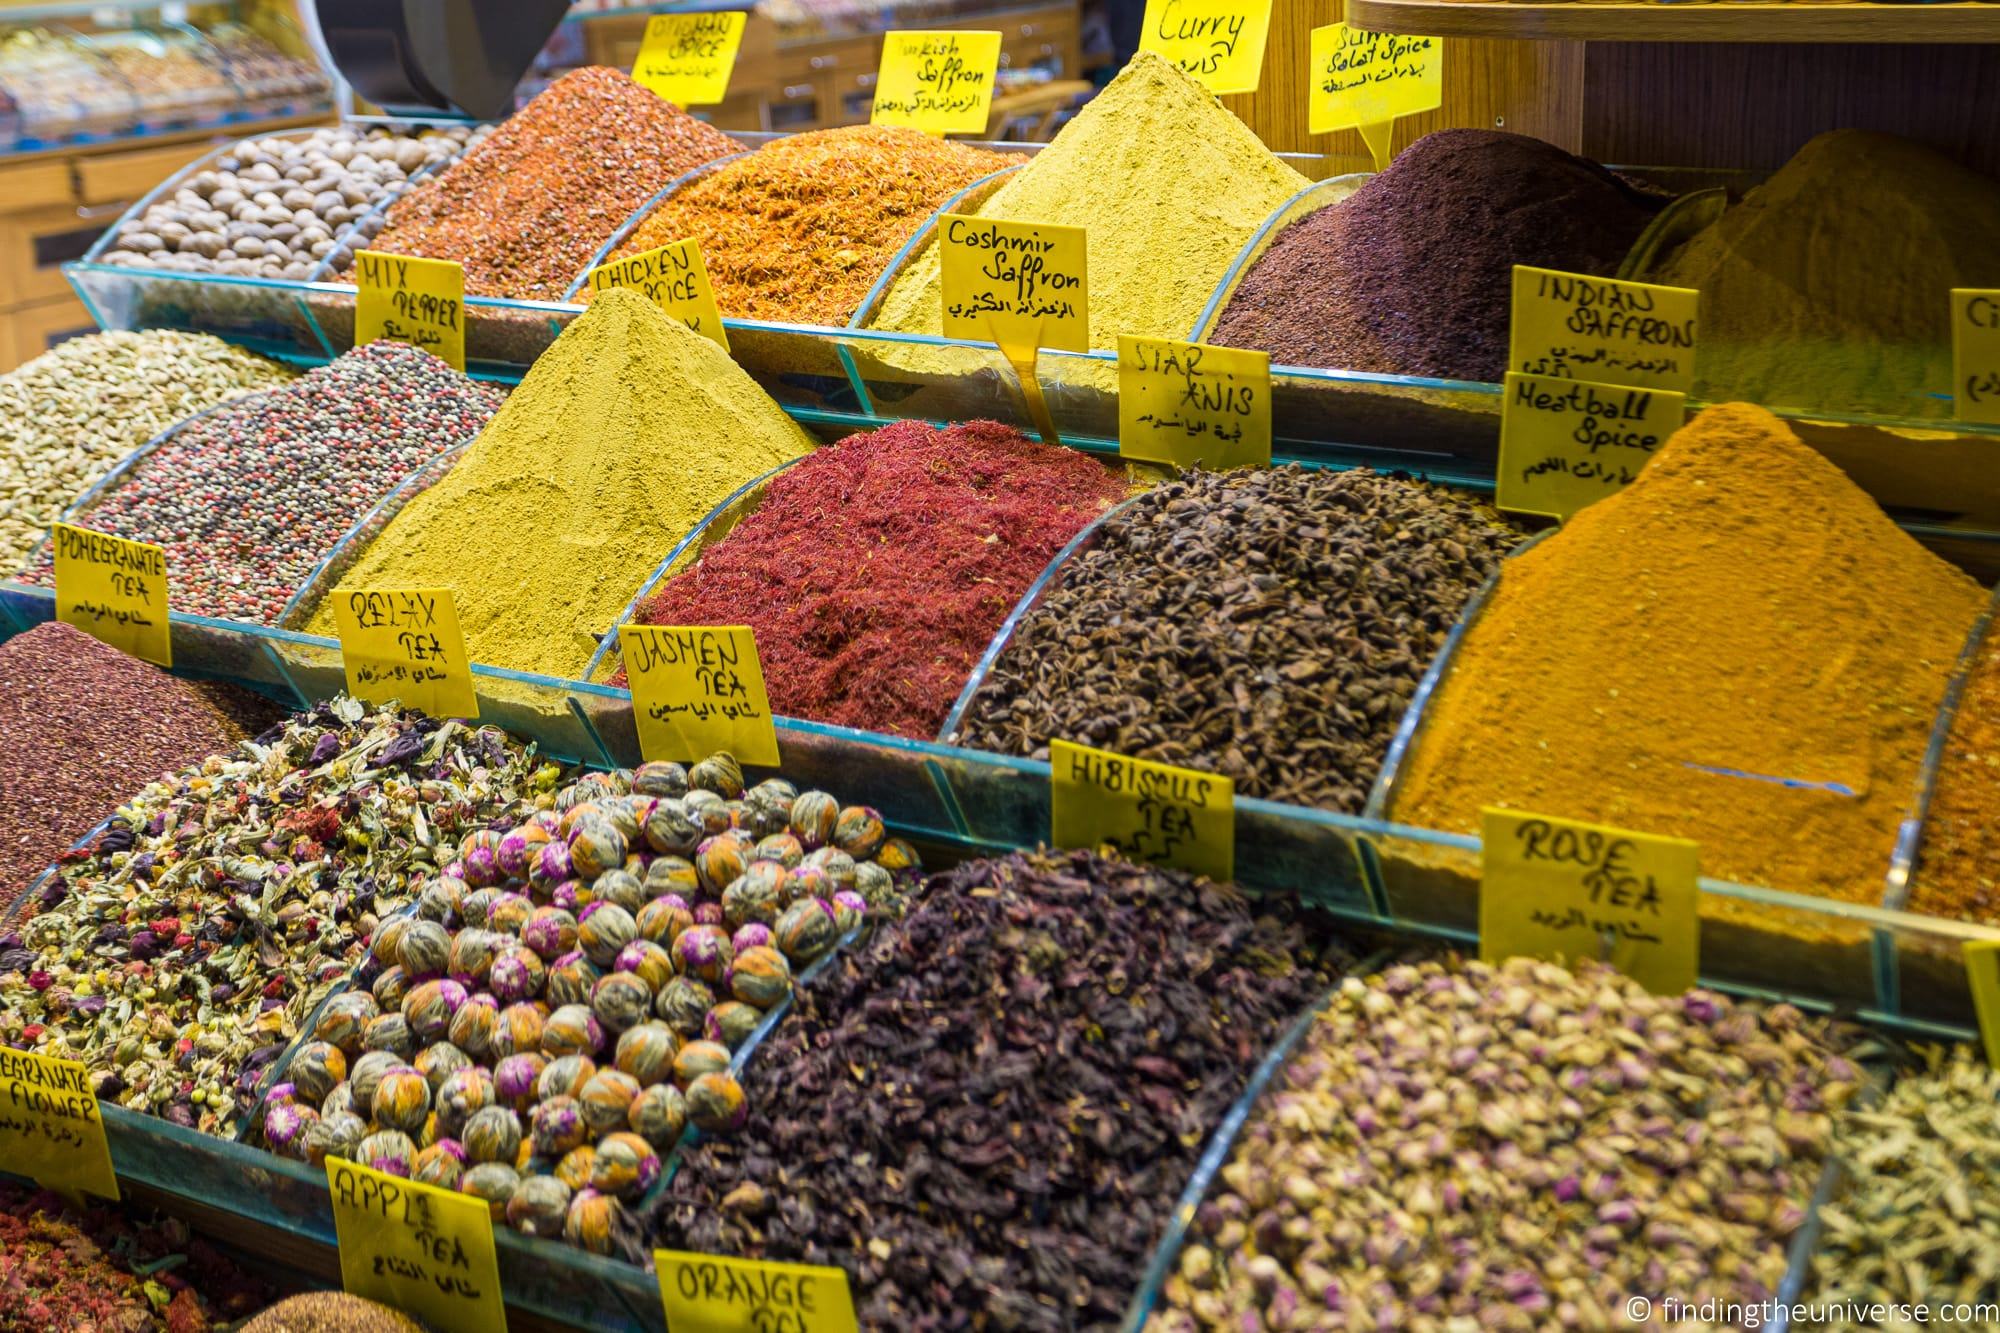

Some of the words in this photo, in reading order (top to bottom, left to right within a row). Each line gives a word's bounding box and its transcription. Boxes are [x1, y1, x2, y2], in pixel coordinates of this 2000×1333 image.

[898, 36, 960, 57] urkish
[1159, 0, 1245, 56] Curry
[1380, 37, 1432, 64] Spice
[917, 57, 985, 93] Saffron
[948, 219, 1056, 252] Cashmir
[362, 257, 407, 288] MIX
[982, 250, 1080, 301] Saffron
[392, 290, 459, 333] PEPPER
[1538, 274, 1655, 312] INDIAN
[1566, 306, 1696, 348] SAFFRON
[1135, 342, 1204, 376] STAR
[1515, 381, 1653, 421] Meatball
[1572, 416, 1659, 453] Spice
[111, 572, 151, 607] TEA
[350, 591, 437, 629] RELAX
[398, 631, 448, 664] TEA
[628, 629, 739, 673] JASMEN
[695, 666, 747, 698] TEA
[1136, 799, 1197, 841] TEA
[1515, 819, 1639, 872] ROSE
[1582, 867, 1662, 916] TEA
[10, 1080, 95, 1124] FLOWER
[415, 1230, 470, 1271] TEA
[677, 1262, 816, 1314] ORANGE
